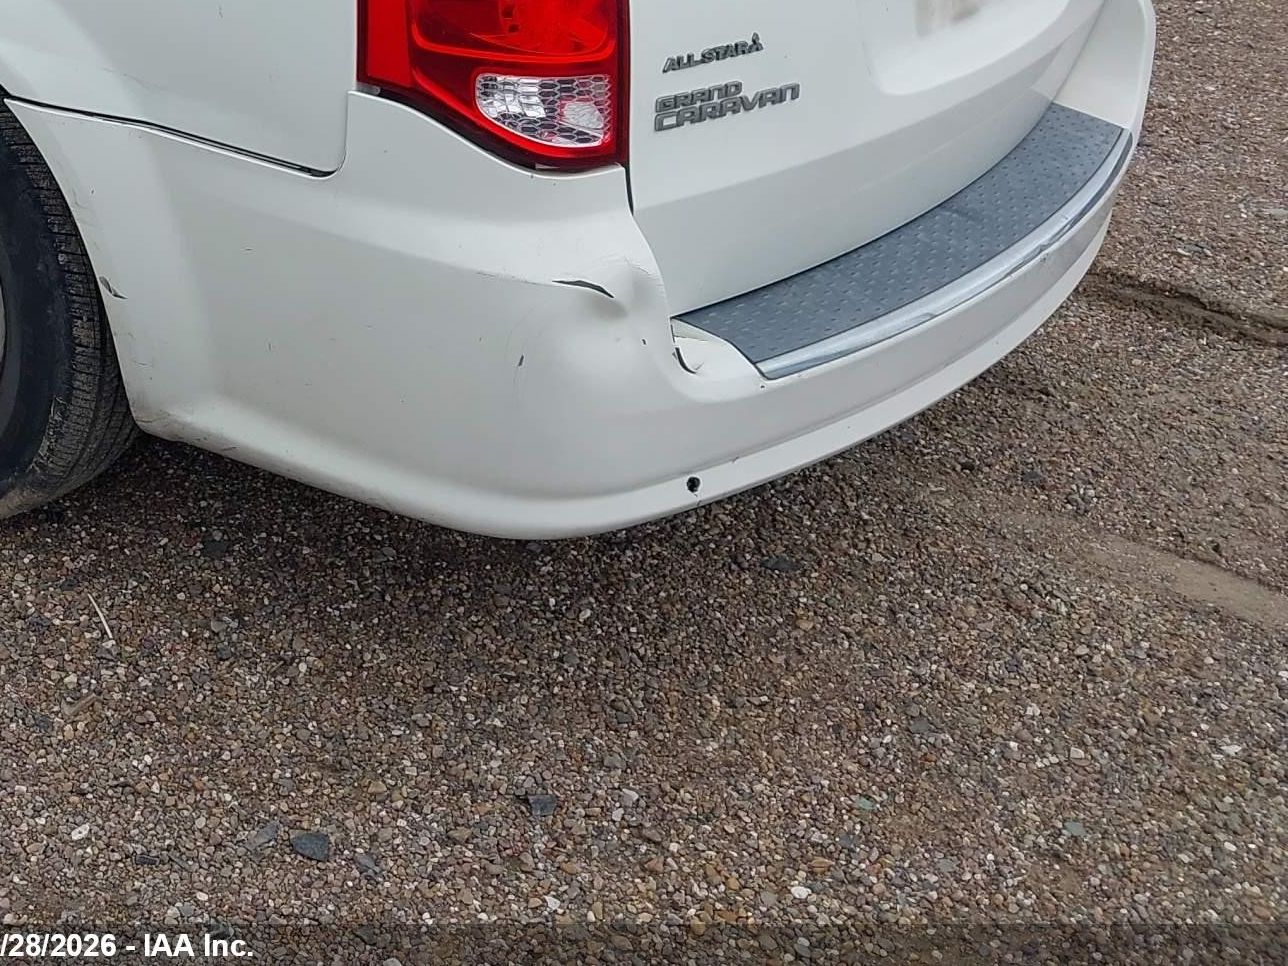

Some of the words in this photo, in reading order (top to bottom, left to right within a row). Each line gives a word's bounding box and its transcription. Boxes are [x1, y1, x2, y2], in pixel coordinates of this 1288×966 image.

[662, 39, 750, 74] ALLSTAR
[654, 83, 801, 132] CARAVAN
[655, 81, 743, 113] GRAND
